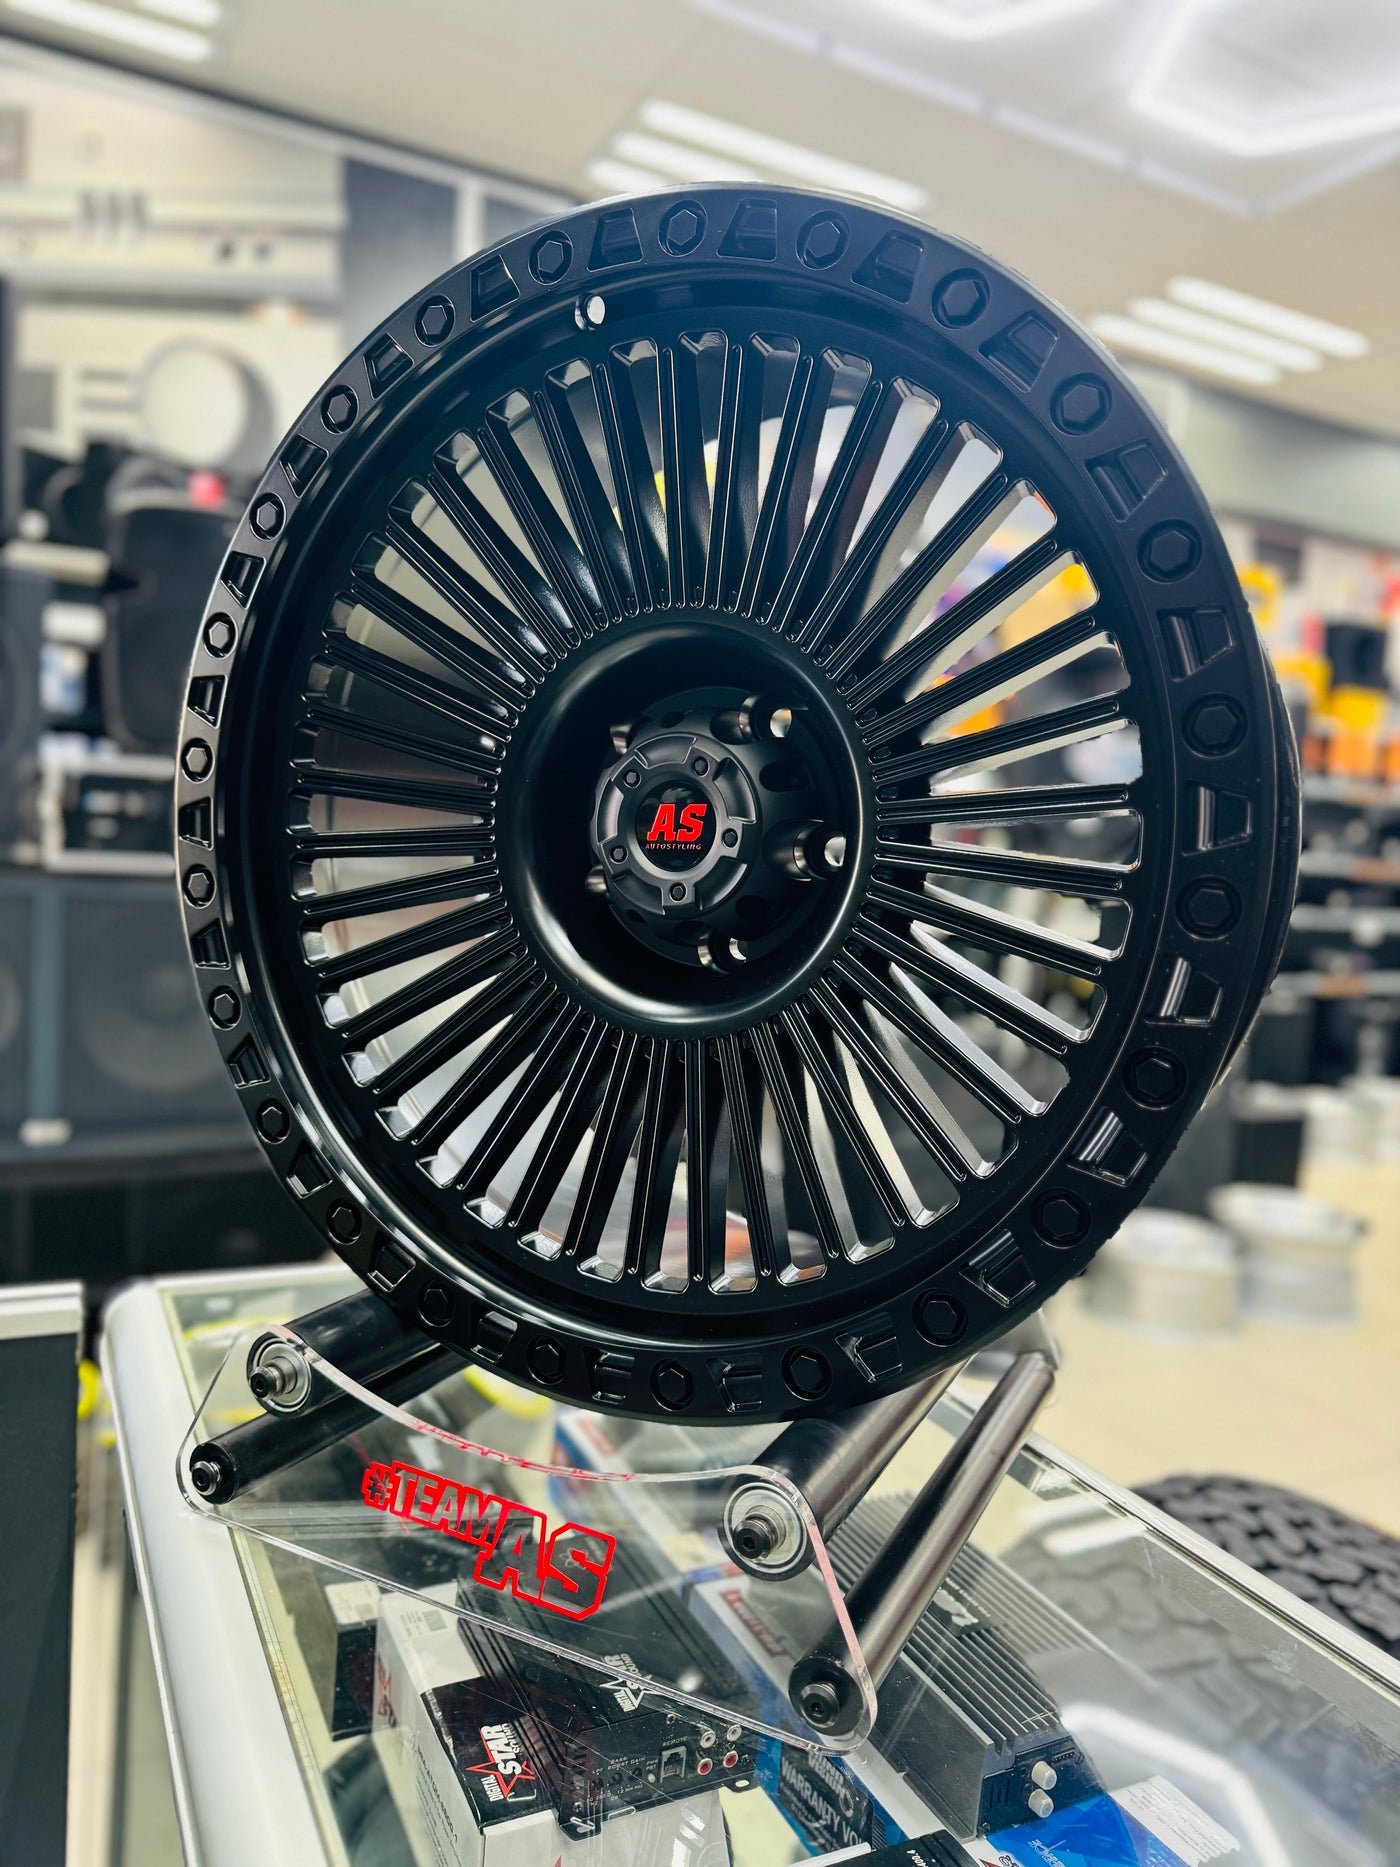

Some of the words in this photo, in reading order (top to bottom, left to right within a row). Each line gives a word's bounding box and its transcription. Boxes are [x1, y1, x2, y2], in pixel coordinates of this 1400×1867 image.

[647, 804, 707, 842] AS
[613, 1690, 636, 1711] DIGITAL
[480, 1724, 522, 1775] STAR
[480, 1774, 504, 1801] DIGITAL
[781, 1757, 841, 1832] WARRANTY
